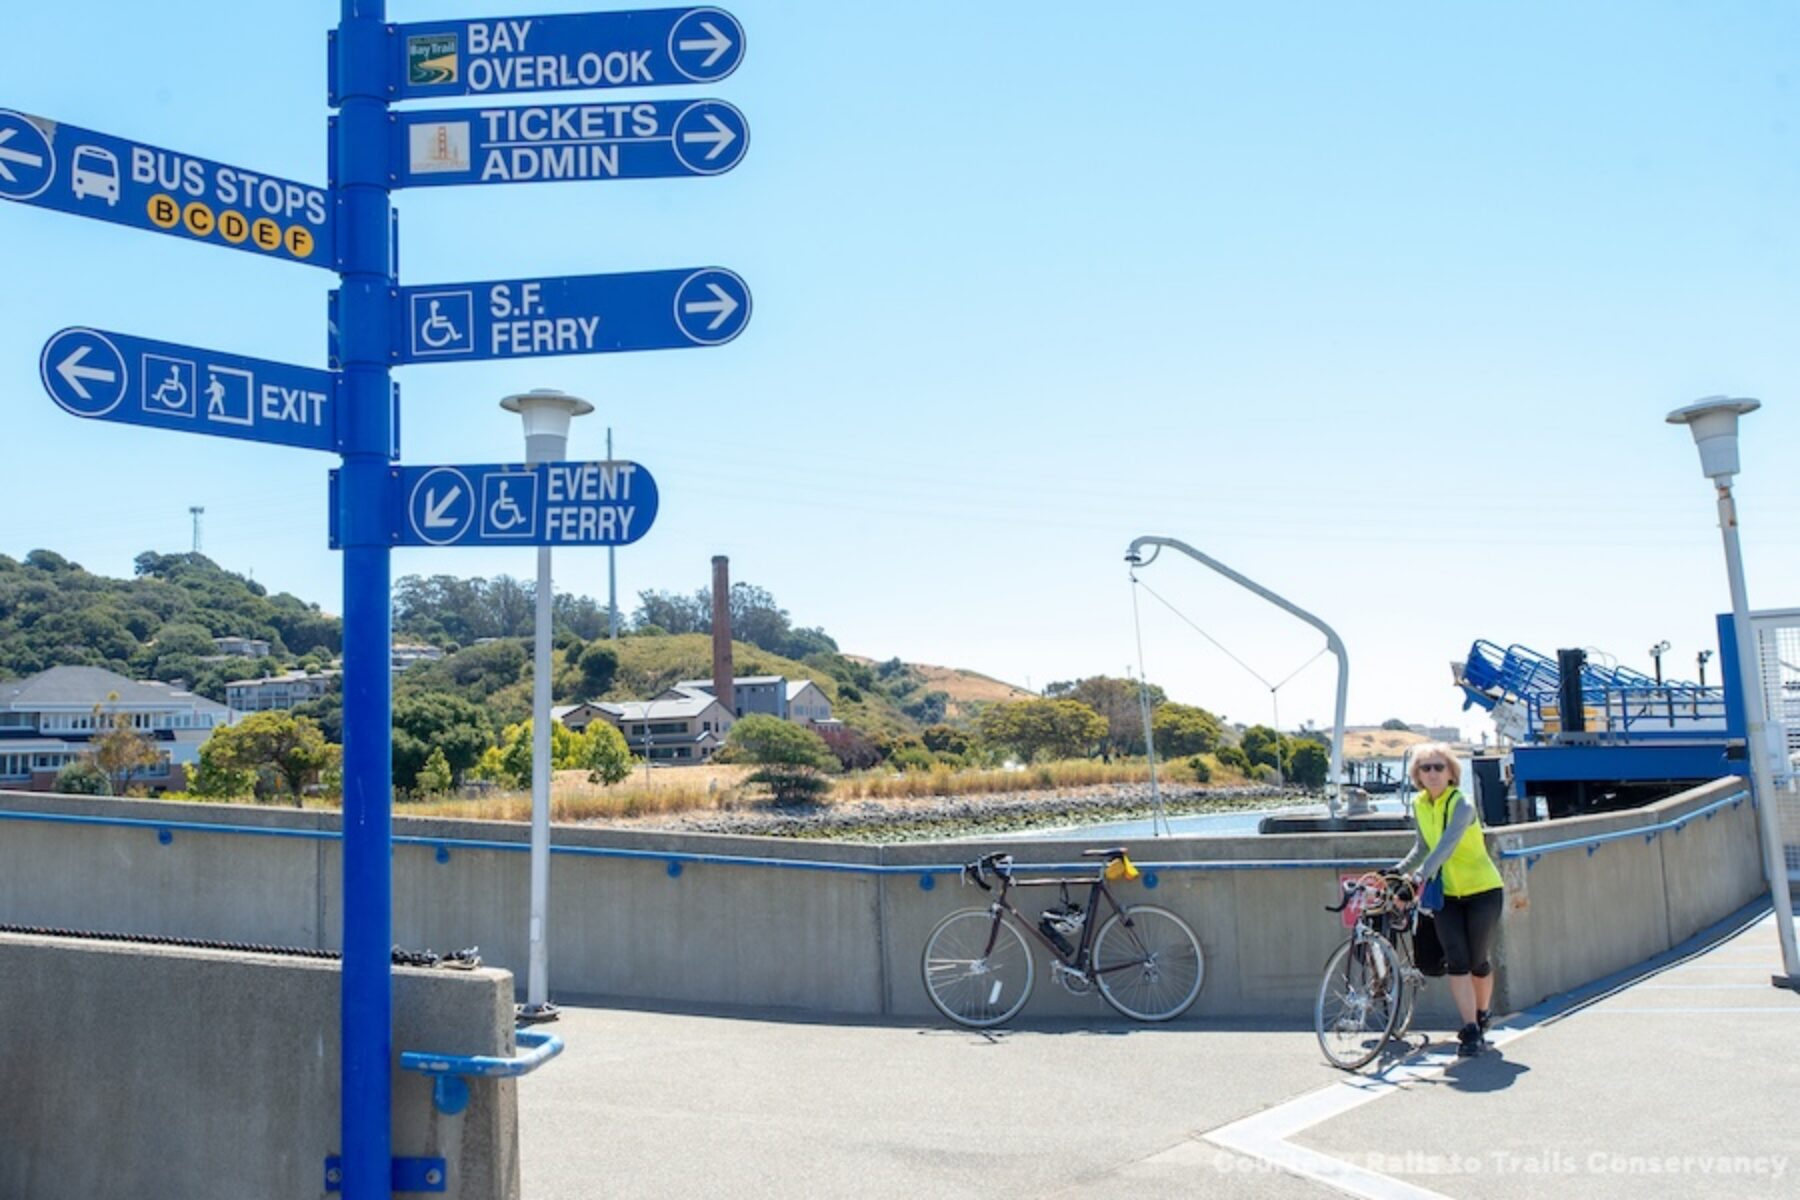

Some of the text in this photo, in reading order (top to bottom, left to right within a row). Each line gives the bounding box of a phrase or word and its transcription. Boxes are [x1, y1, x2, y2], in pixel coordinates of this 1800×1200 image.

[468, 21, 532, 54] BAY
[468, 51, 654, 90] OVERLOOK
[481, 104, 658, 141] TICKETS
[481, 145, 619, 181] ADMIN
[132, 146, 327, 225] BUS STOPS
[155, 200, 306, 252] B C D E F
[490, 283, 545, 318] S.F.
[491, 317, 600, 354] FERRY
[261, 383, 327, 426] EXIT
[547, 465, 636, 501] EVENT
[545, 505, 636, 541] FERRY
